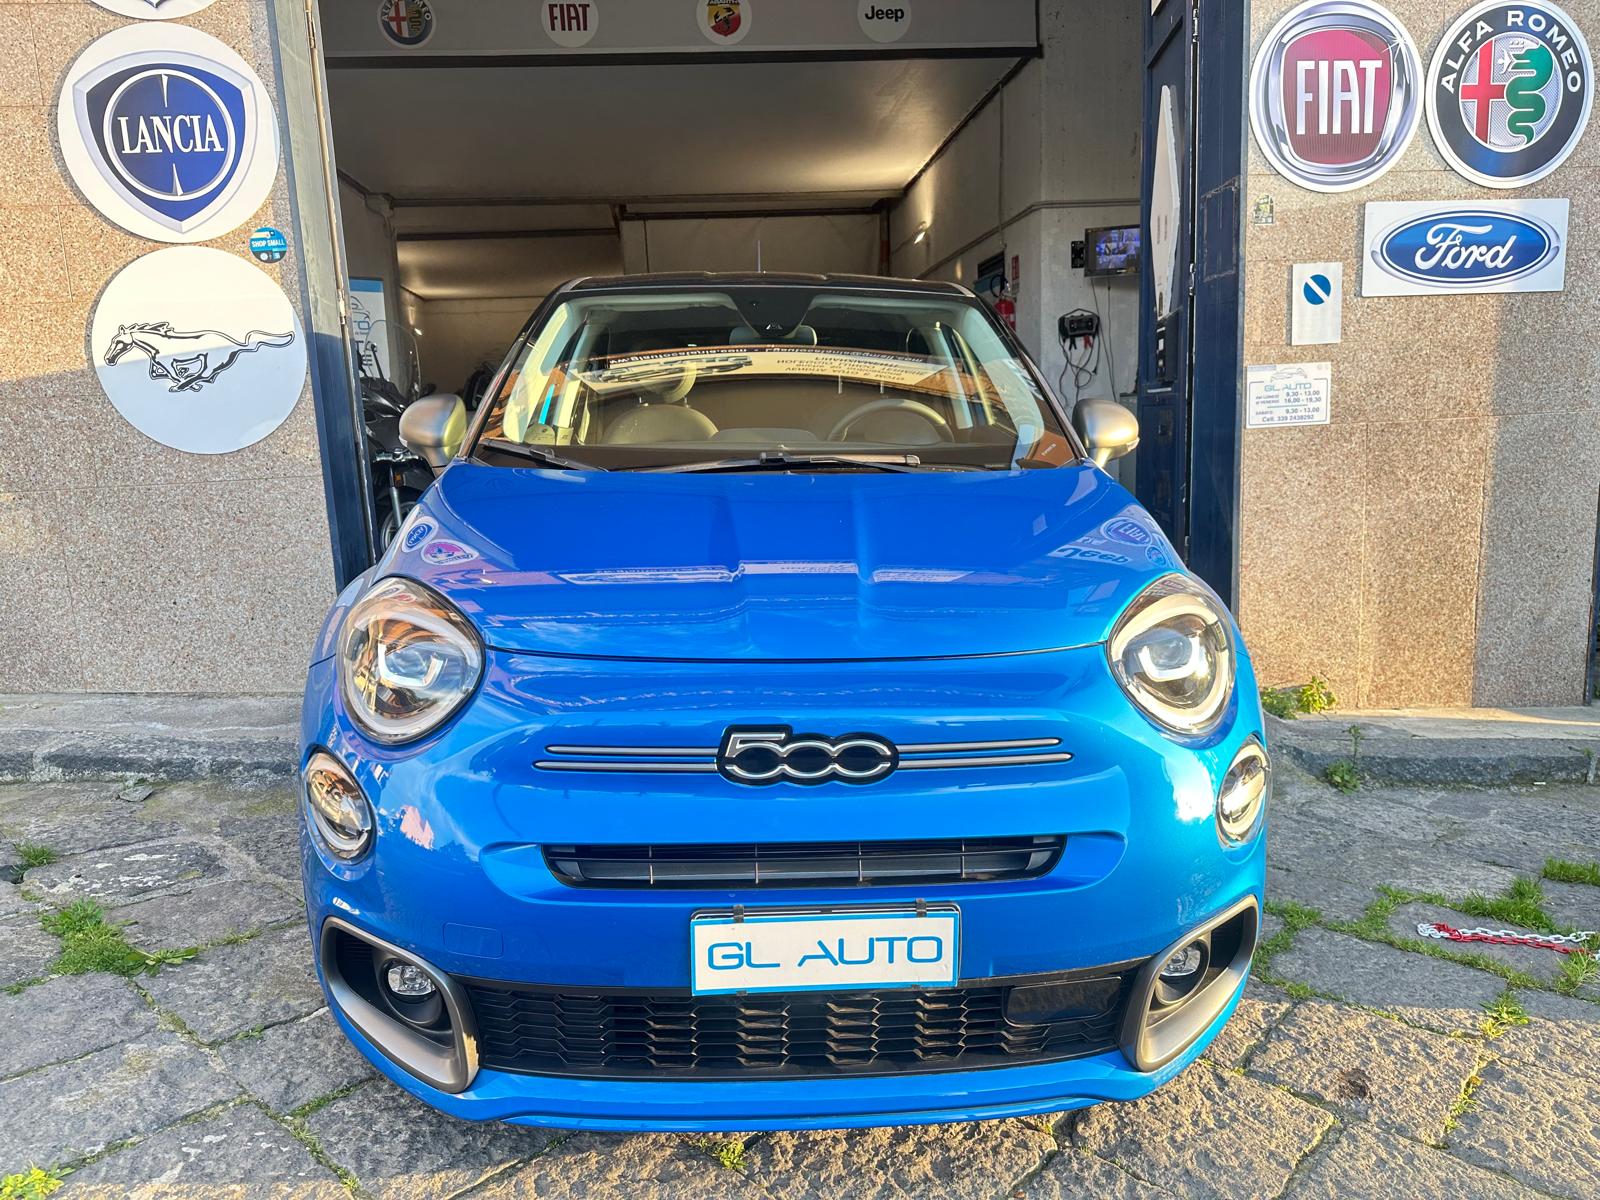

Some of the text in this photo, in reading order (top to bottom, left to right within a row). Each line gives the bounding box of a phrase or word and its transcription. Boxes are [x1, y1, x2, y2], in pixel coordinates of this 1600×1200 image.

[547, 3, 590, 32] FIAT
[864, 5, 905, 22] Jeep
[1440, 10, 1581, 94] ALFA ROMEO
[1296, 60, 1383, 135] FIAT
[117, 113, 225, 155] LANCIA
[251, 238, 285, 248] SHOP SMALL
[1414, 223, 1516, 271] Ford
[1264, 382, 1312, 392] GL AUTO
[722, 728, 894, 783] 500
[707, 935, 943, 971] GL AUTO
